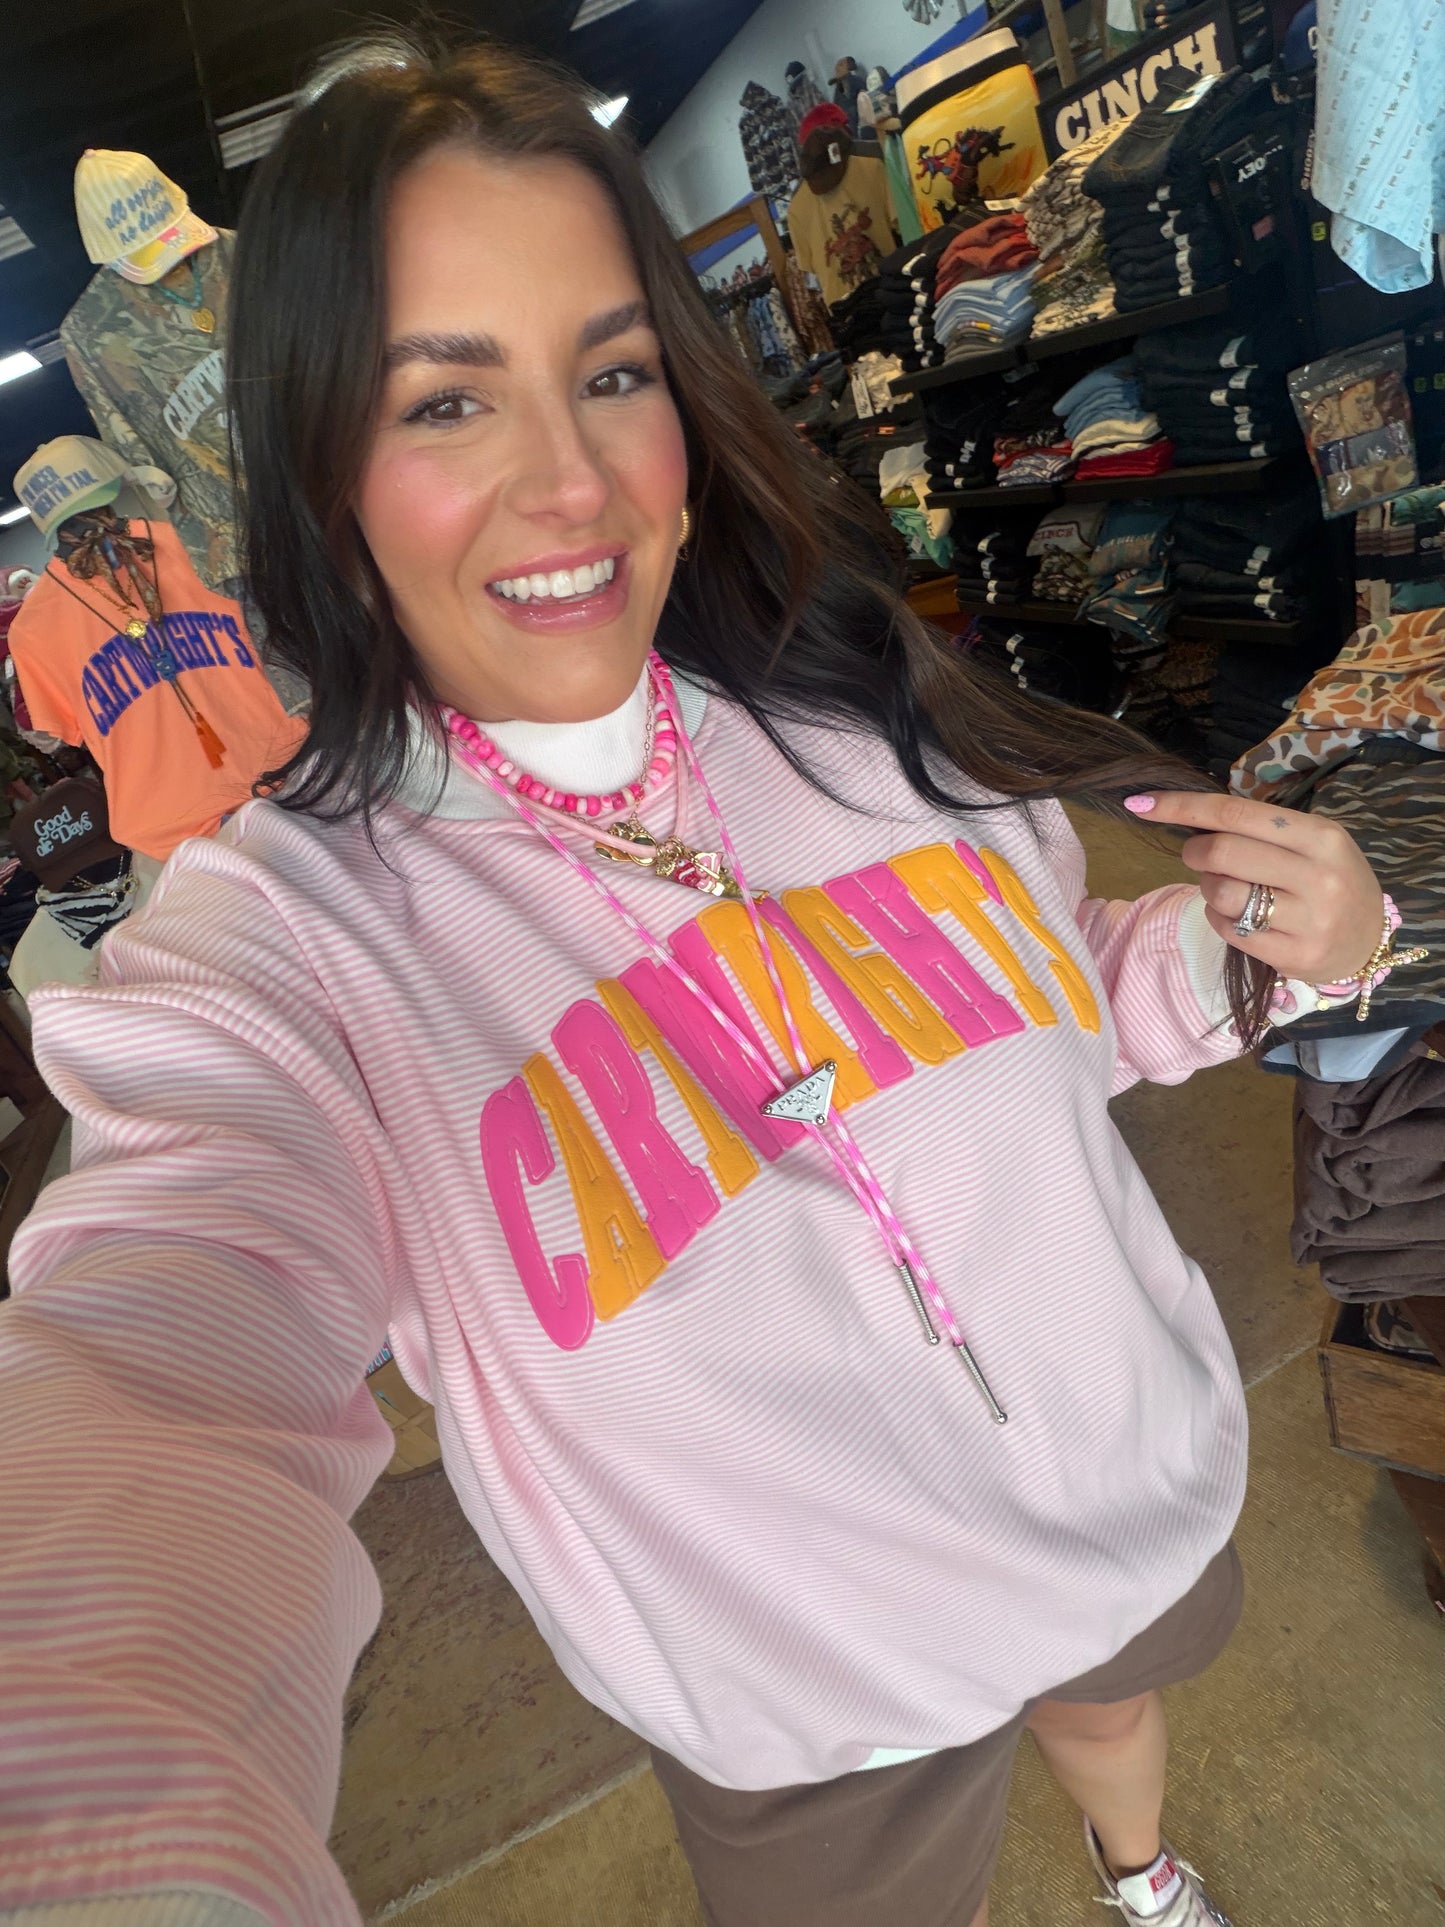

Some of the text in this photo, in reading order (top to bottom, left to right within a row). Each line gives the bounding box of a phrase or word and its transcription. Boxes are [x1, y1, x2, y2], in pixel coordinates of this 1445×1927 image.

[1055, 22, 1223, 150] CINCH
[34, 804, 73, 841] Good
[50, 811, 93, 844] Days
[481, 838, 1101, 1351] CARTWRIGHT'S
[776, 1076, 826, 1111] PRADA
